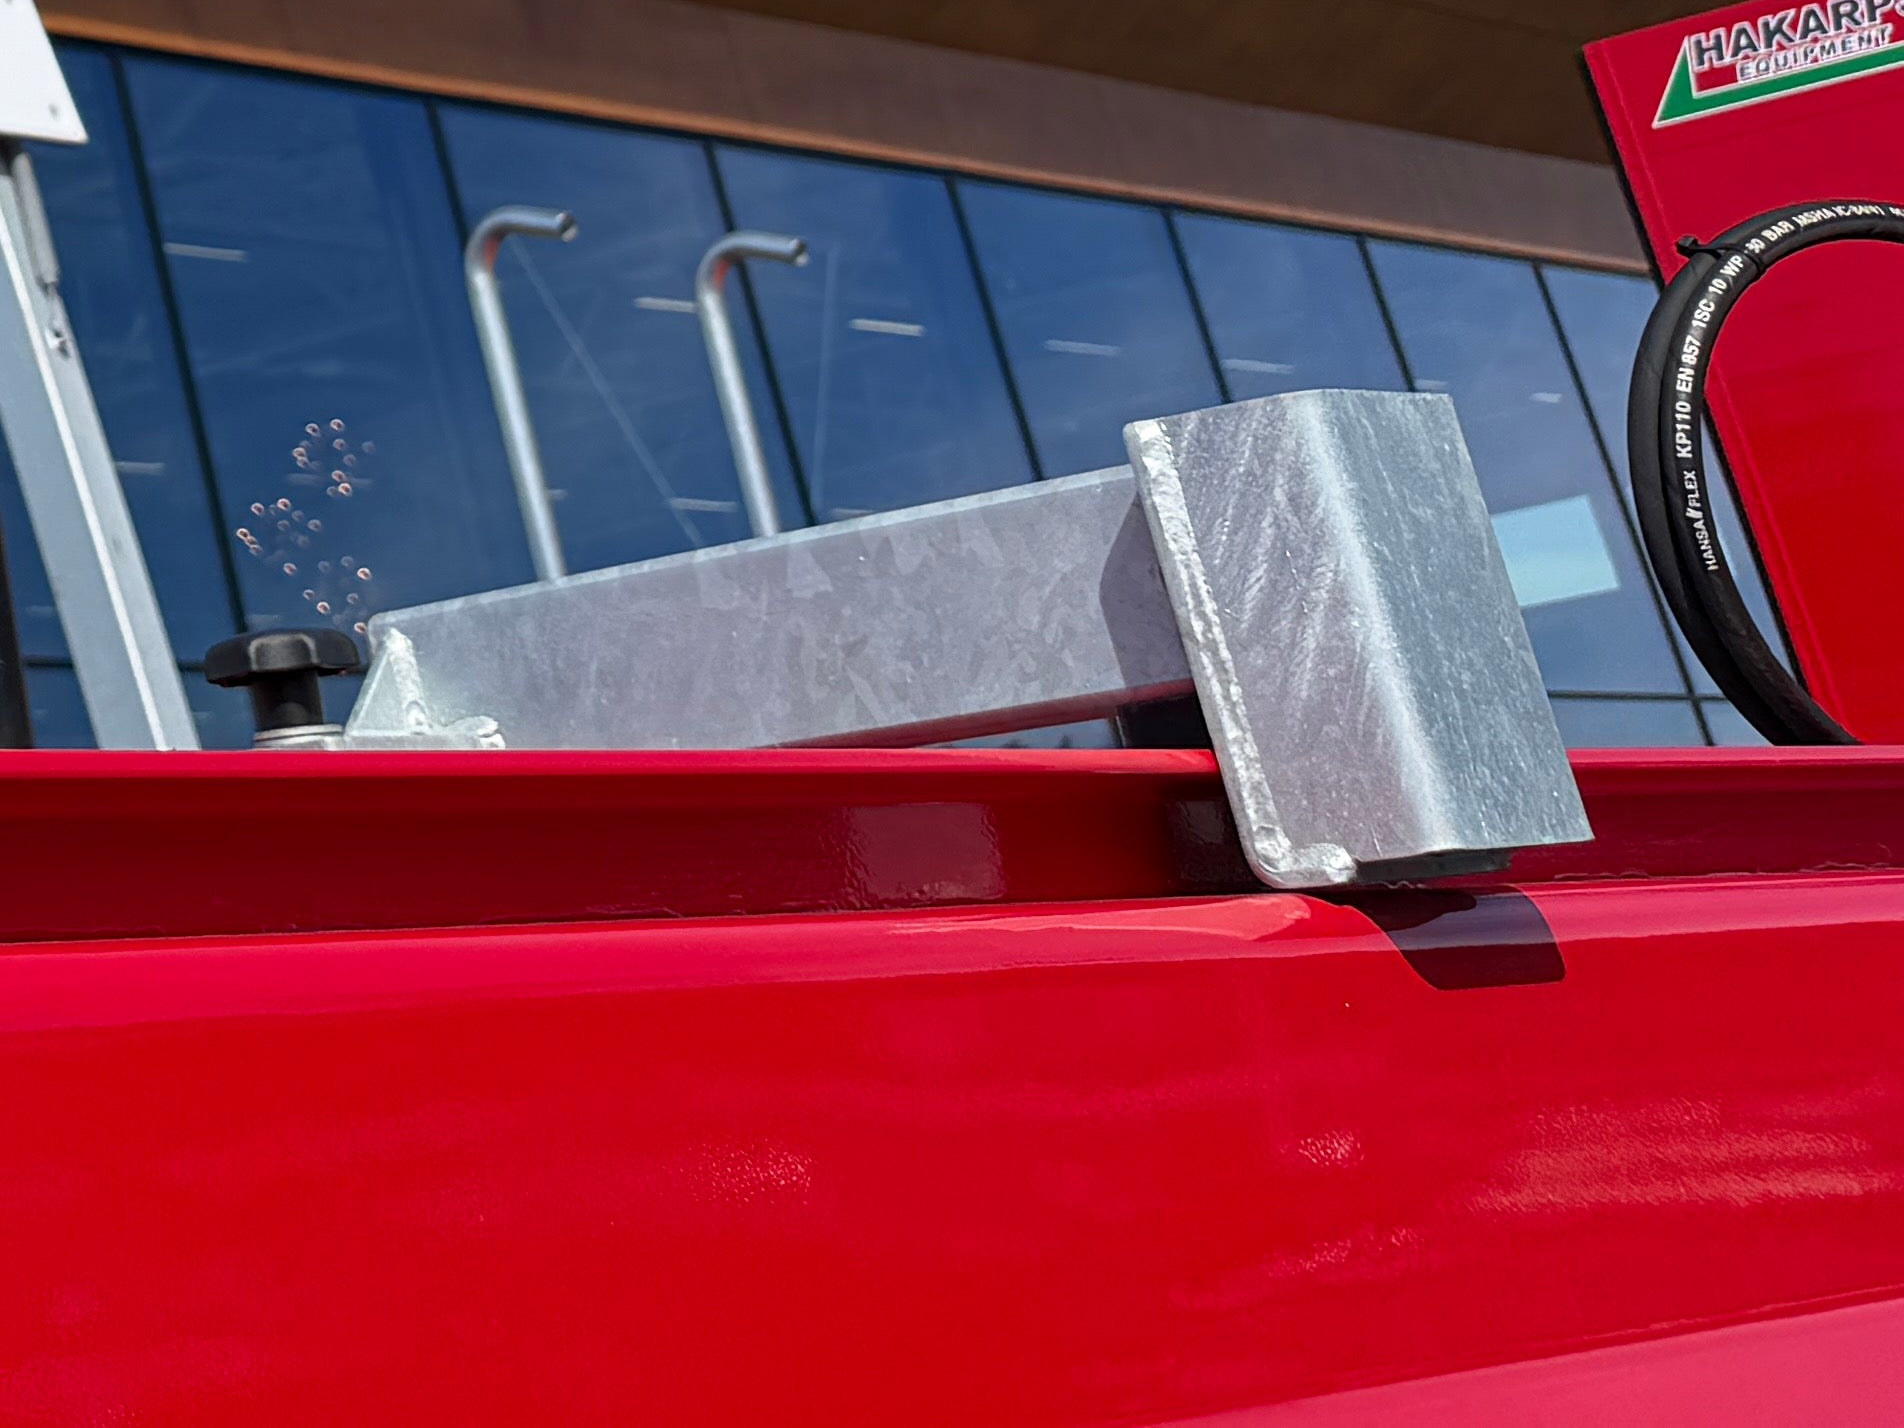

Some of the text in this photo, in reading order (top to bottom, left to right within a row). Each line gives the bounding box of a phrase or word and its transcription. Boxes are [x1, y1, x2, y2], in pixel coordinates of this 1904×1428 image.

[1737, 24, 1892, 83] EQUIPMENT
[1760, 221, 1795, 241] BAR
[1719, 254, 1745, 278] WP
[1707, 277, 1728, 295] 10
[1691, 298, 1716, 329] 1SC
[1681, 334, 1701, 365] 857
[1676, 366, 1695, 393] EN
[1676, 401, 1692, 459] KP110
